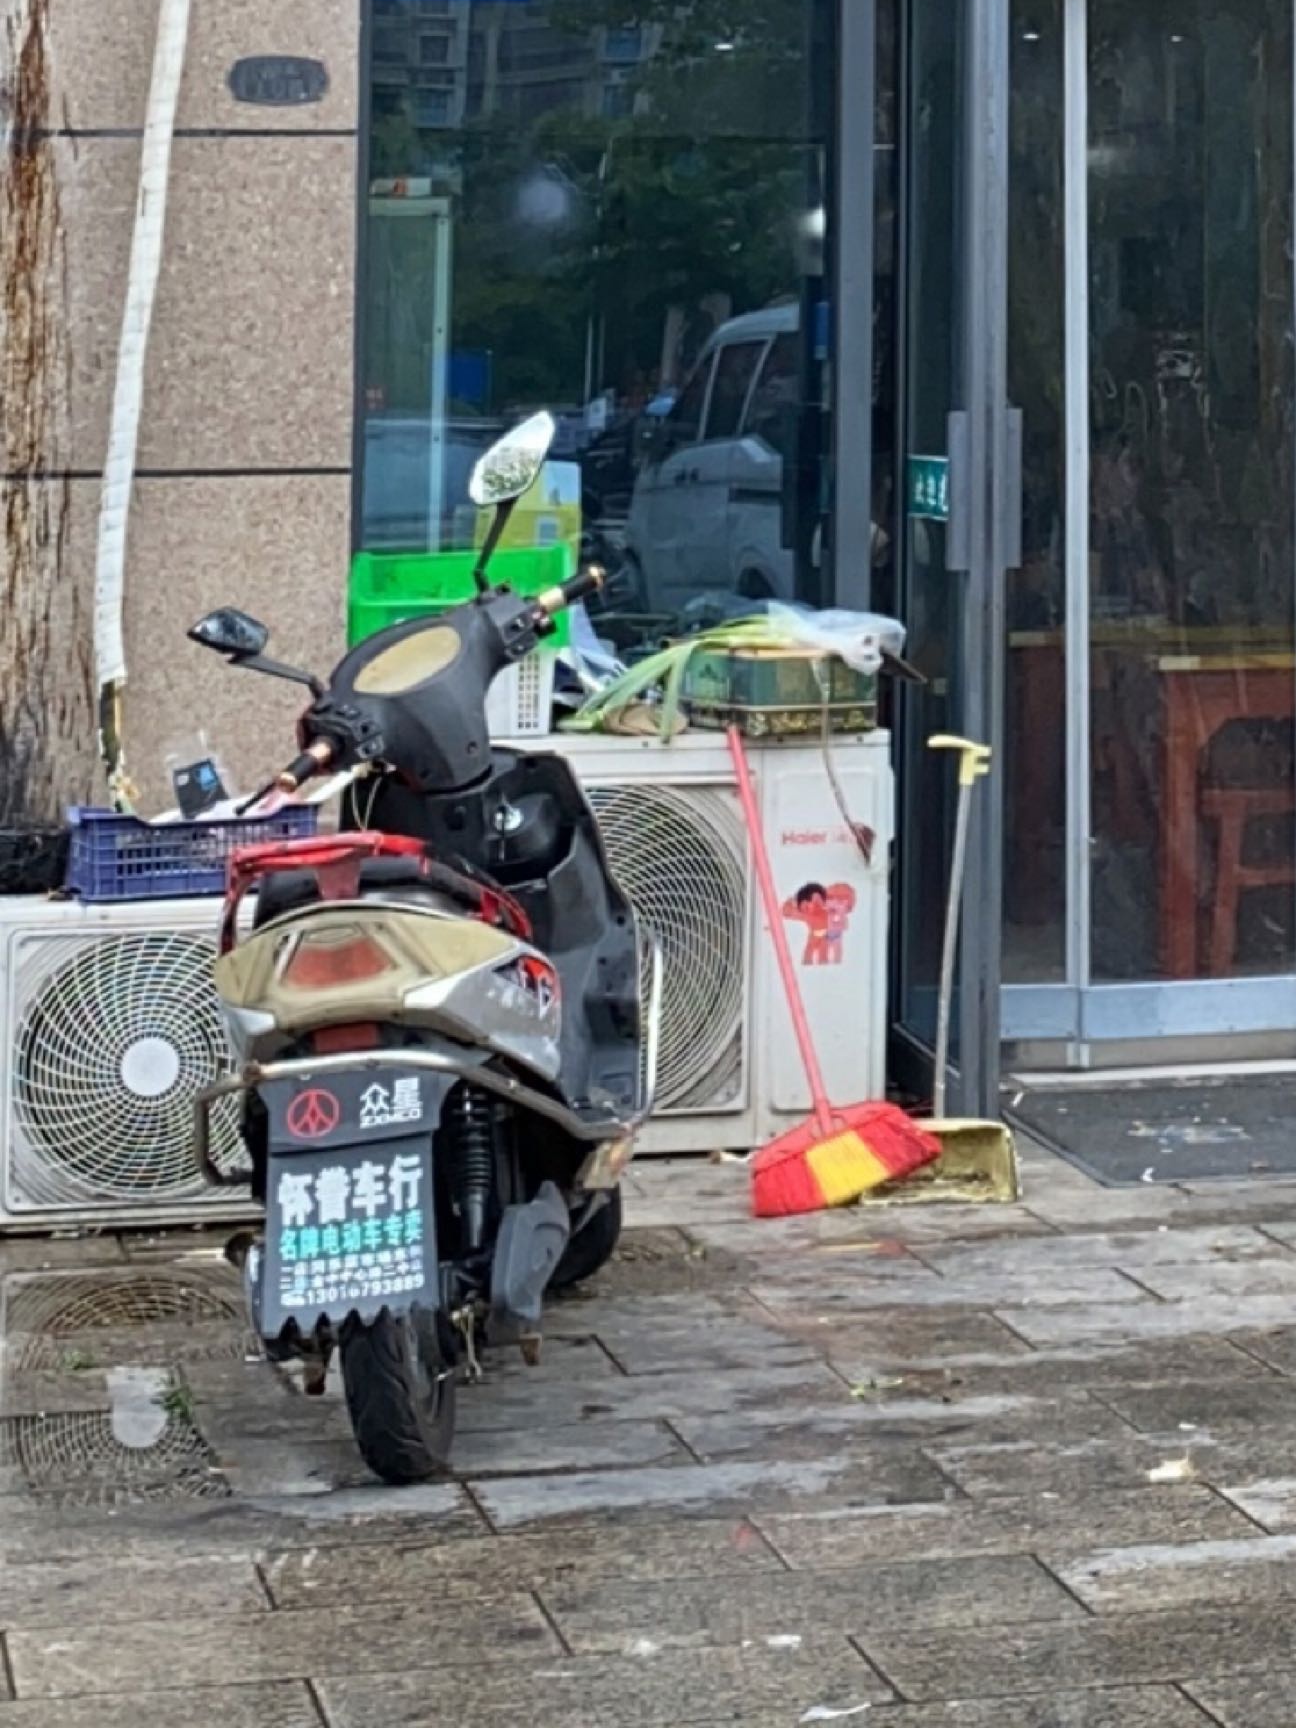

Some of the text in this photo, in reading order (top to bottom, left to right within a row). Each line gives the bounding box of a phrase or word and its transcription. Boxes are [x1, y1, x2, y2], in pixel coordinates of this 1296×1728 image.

[782, 829, 828, 845] Haier
[279, 1208, 424, 1261] 名牌电动车专卖
